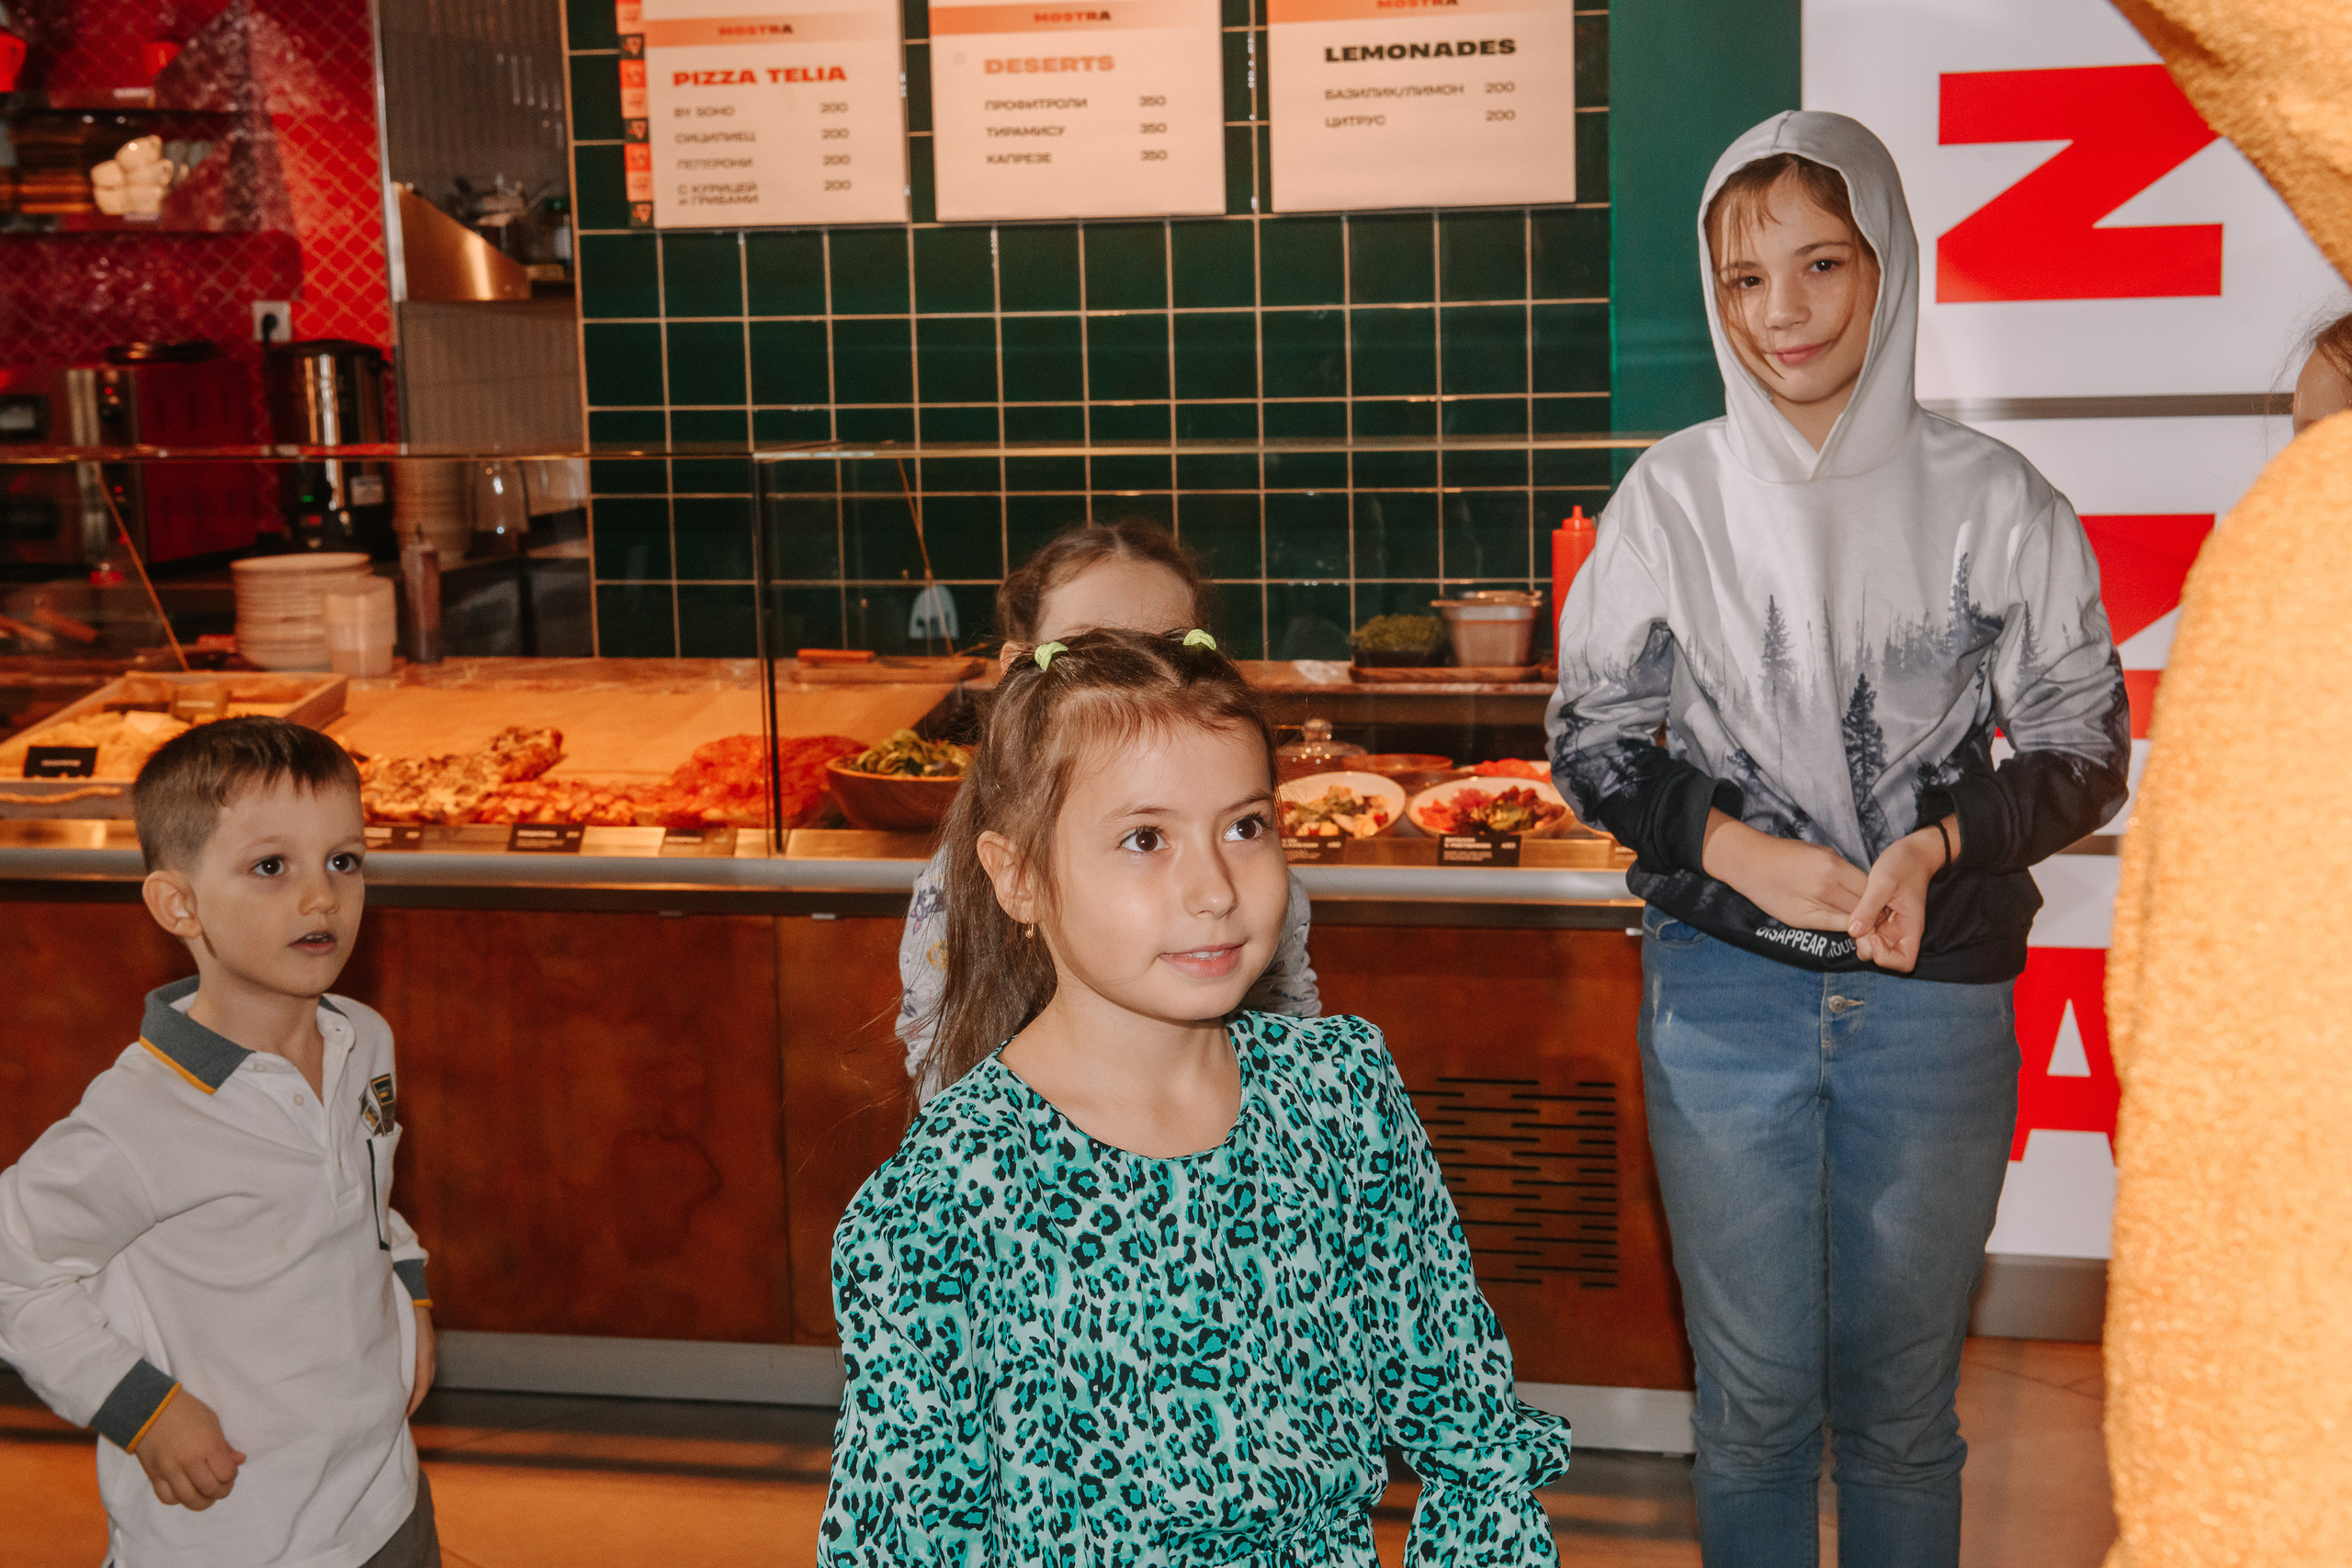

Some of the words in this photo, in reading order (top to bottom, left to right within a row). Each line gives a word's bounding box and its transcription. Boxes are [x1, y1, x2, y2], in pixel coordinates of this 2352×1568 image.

[1035, 10, 1111, 22] MOSTRA
[1325, 39, 1516, 62] LEMONADES
[984, 55, 1114, 74] DESERTS
[673, 70, 757, 86] PIZZA
[767, 66, 846, 83] TELIA
[1325, 85, 1464, 100] БАЗИЛИК/ЛИМОН
[1486, 82, 1516, 94] 200
[820, 102, 848, 113] 200
[1140, 96, 1167, 107] 350
[1486, 109, 1516, 121] 200
[822, 128, 850, 140] 200
[987, 126, 1065, 137] ТИРАМИСУ
[1141, 123, 1167, 134] 350
[823, 154, 851, 166] 200
[987, 152, 1051, 164] КАПРЕЗЕ
[1141, 150, 1168, 161] 350
[824, 180, 852, 191] 200
